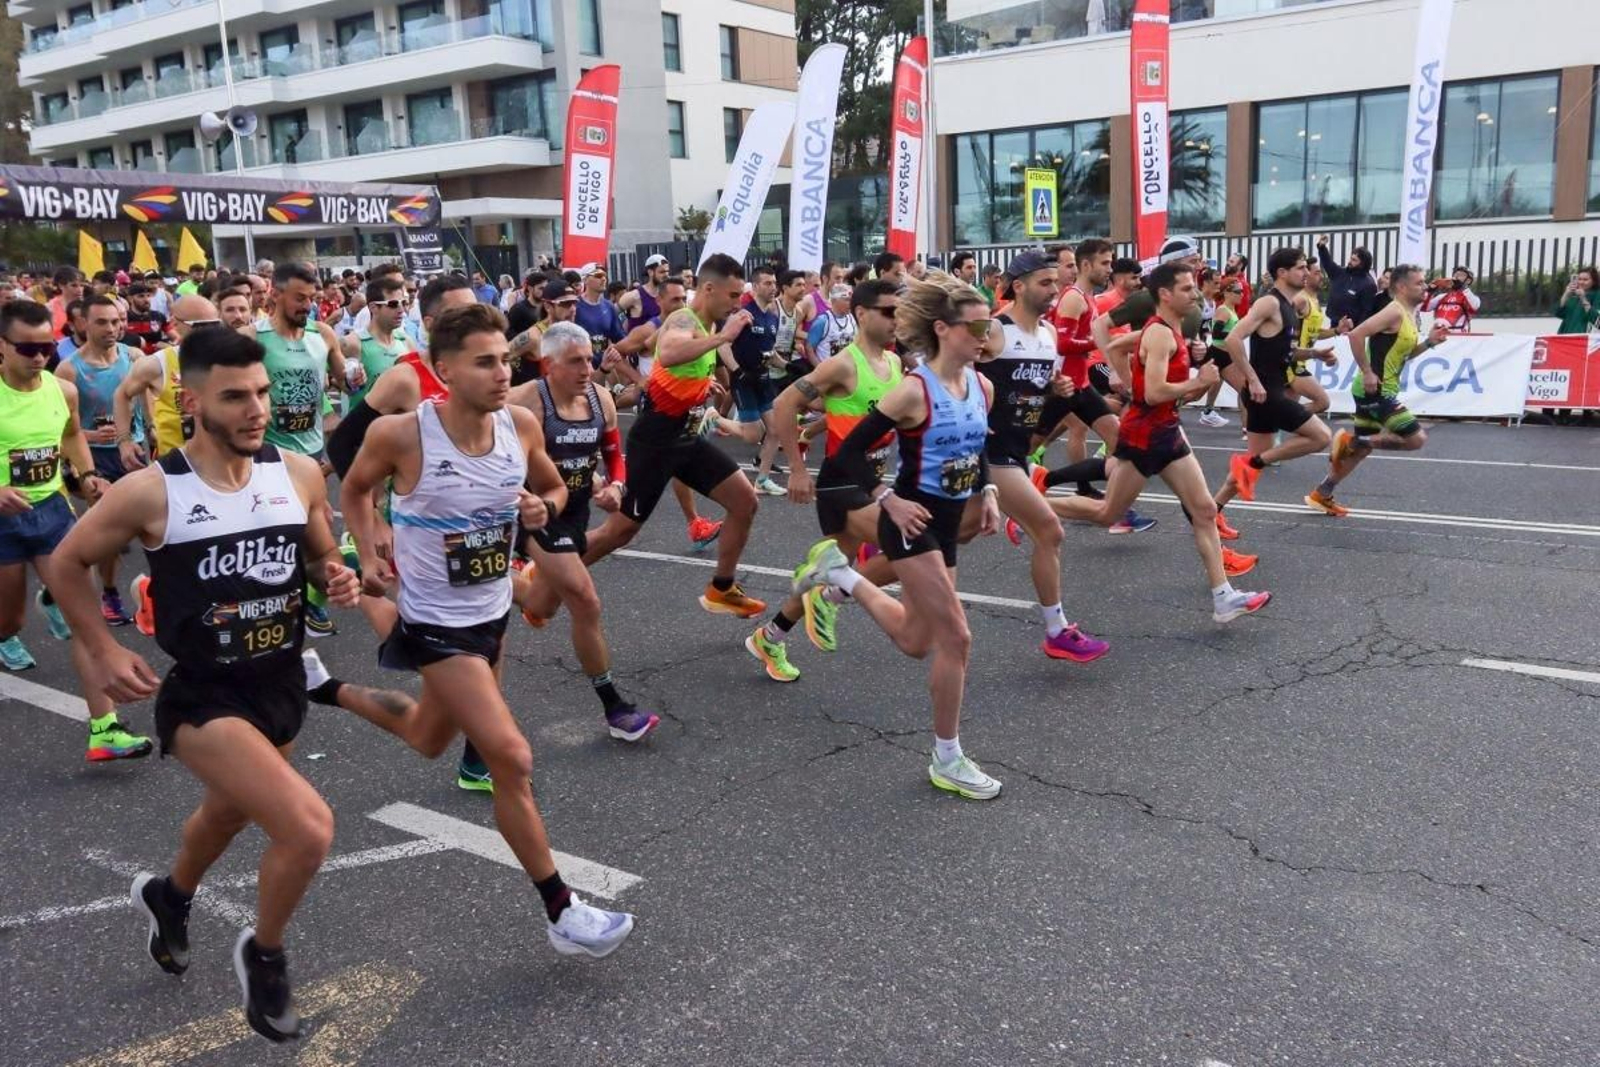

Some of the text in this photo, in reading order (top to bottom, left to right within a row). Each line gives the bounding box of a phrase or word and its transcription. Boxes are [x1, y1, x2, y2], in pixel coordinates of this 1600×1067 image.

[576, 161, 590, 229] CONCELLO
[588, 170, 602, 223] DE VIGO
[728, 151, 763, 225] aqualia
[1528, 385, 1559, 399] Vigo
[289, 417, 309, 430] 277
[27, 465, 52, 480] 113
[566, 474, 583, 486] 46
[198, 535, 297, 580] delikia
[469, 553, 506, 577] 318
[261, 567, 287, 578] fresh
[244, 624, 284, 651] 199
